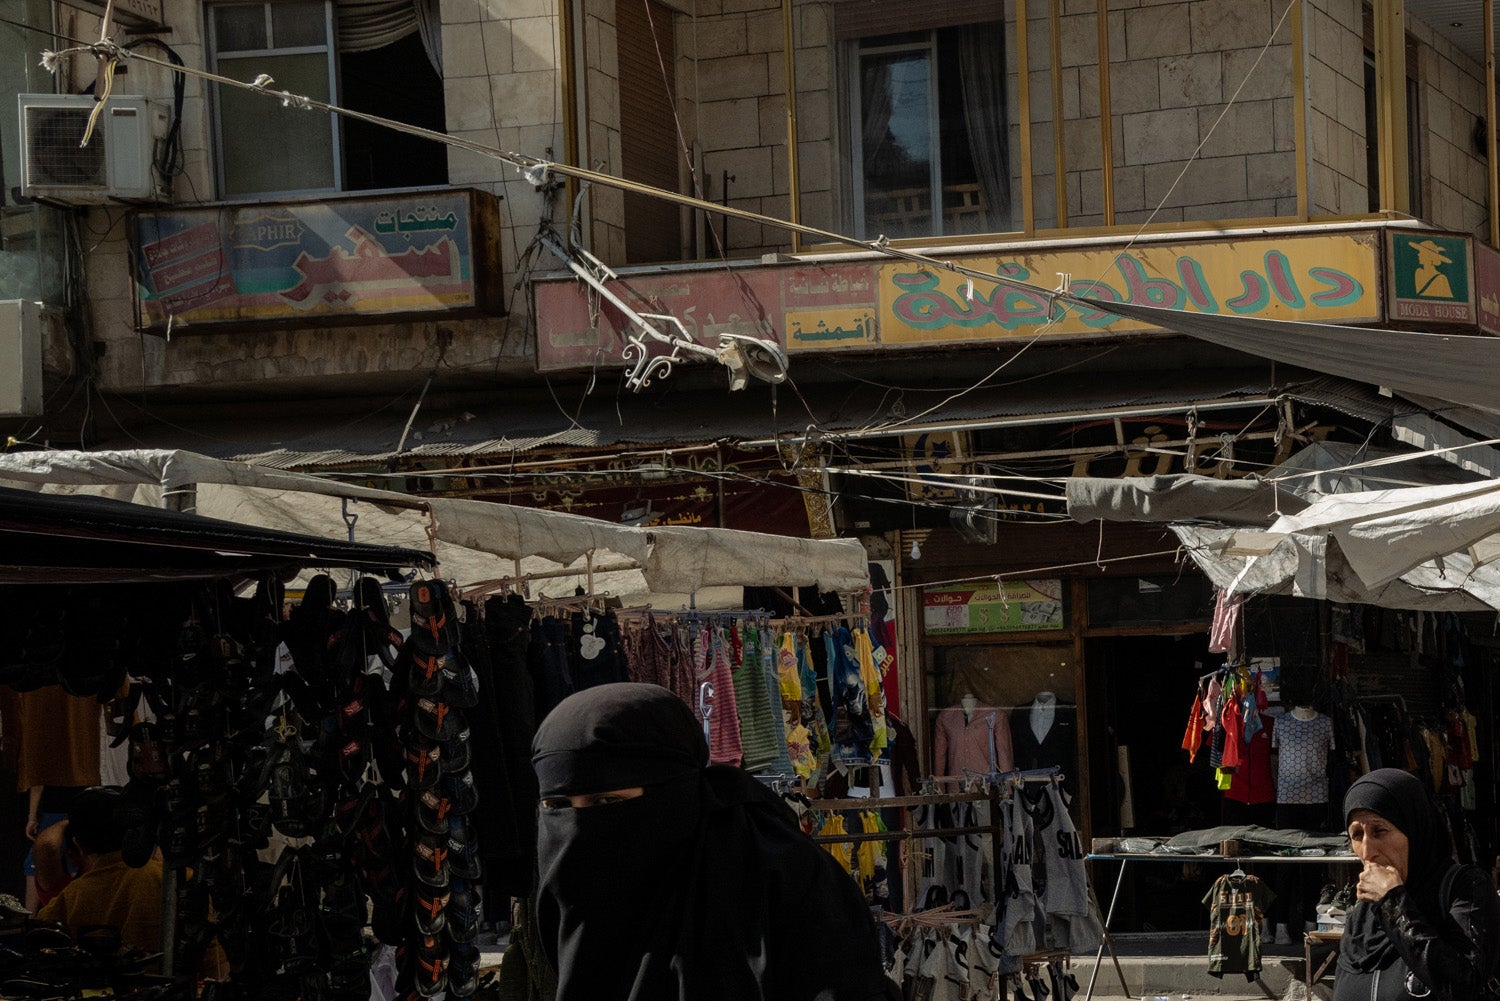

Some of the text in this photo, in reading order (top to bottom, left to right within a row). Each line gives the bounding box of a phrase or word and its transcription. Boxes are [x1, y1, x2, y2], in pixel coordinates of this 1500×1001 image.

[374, 206, 459, 241] منتجات
[278, 225, 458, 306] سفير
[789, 273, 869, 299] خياطة نسائية
[891, 249, 1364, 330] دار الموضة
[1400, 304, 1469, 319] MODA HOUSE
[792, 312, 873, 341] أقمشة
[933, 594, 962, 603] حوالات
